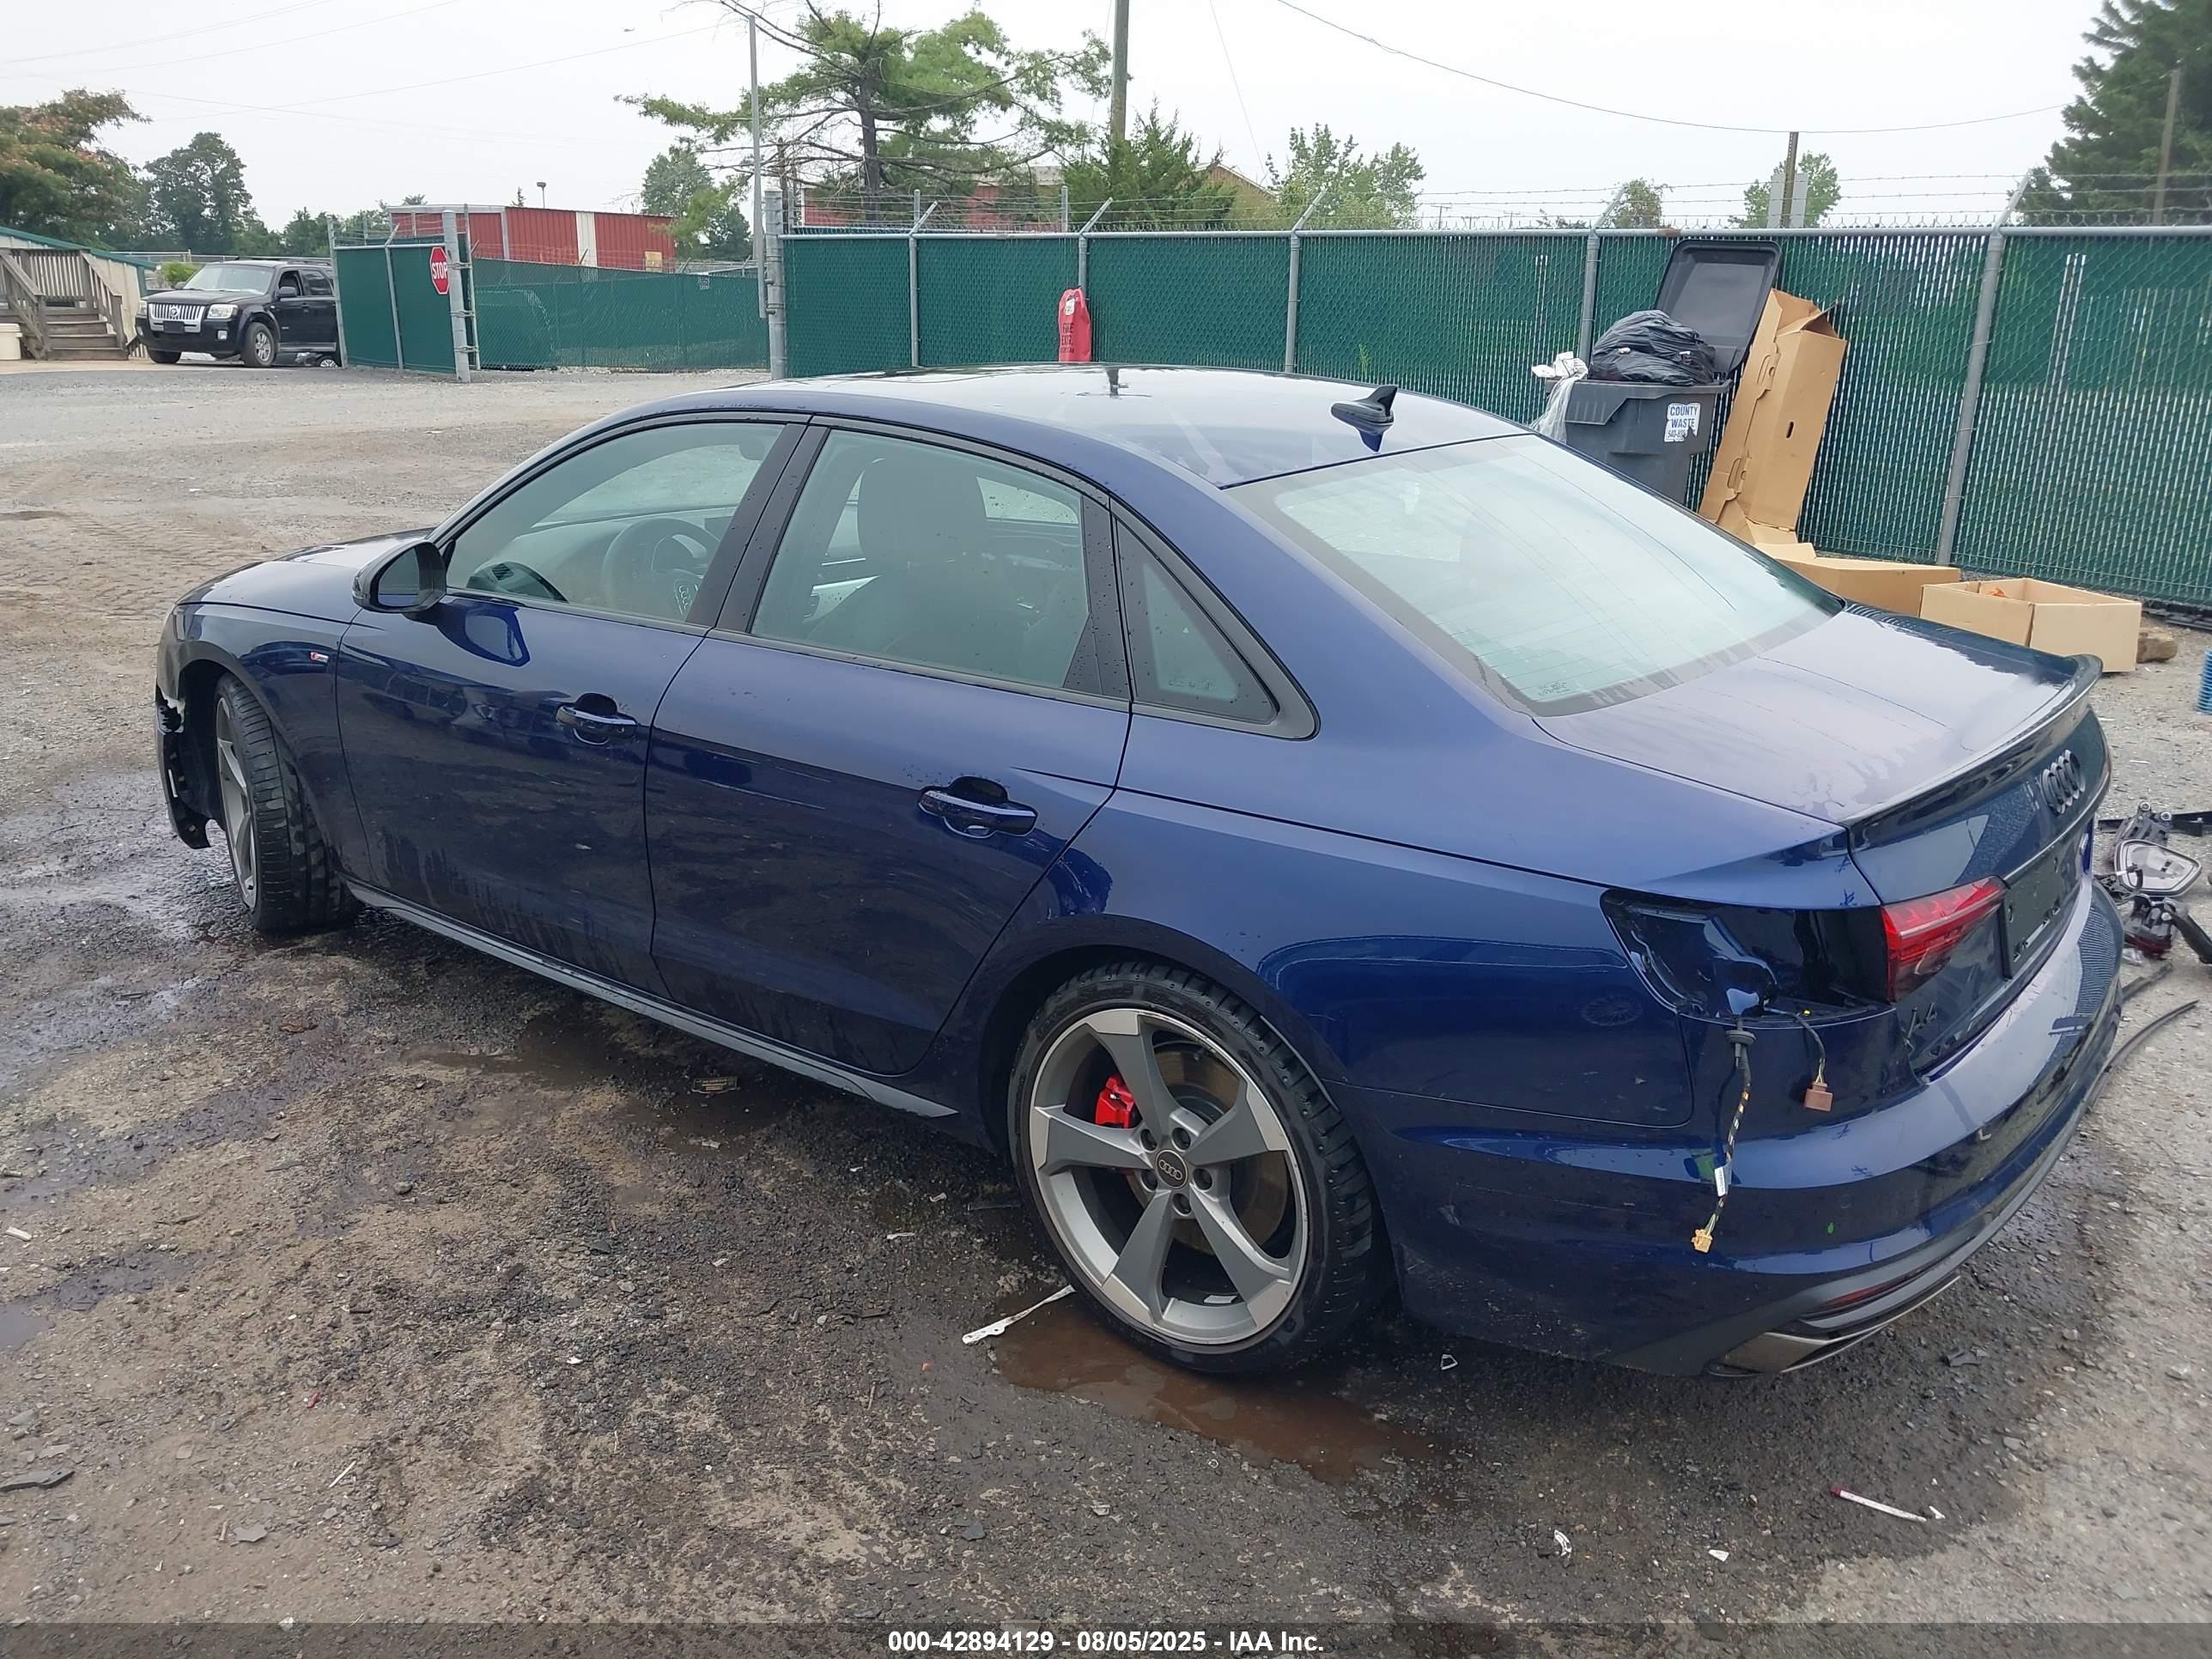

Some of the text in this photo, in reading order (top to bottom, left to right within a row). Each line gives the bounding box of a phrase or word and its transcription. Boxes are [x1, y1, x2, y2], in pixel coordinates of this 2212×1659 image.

[432, 262, 447, 279] STOP
[1670, 406, 1698, 416] COUNTY
[1671, 418, 1695, 428] WASTE
